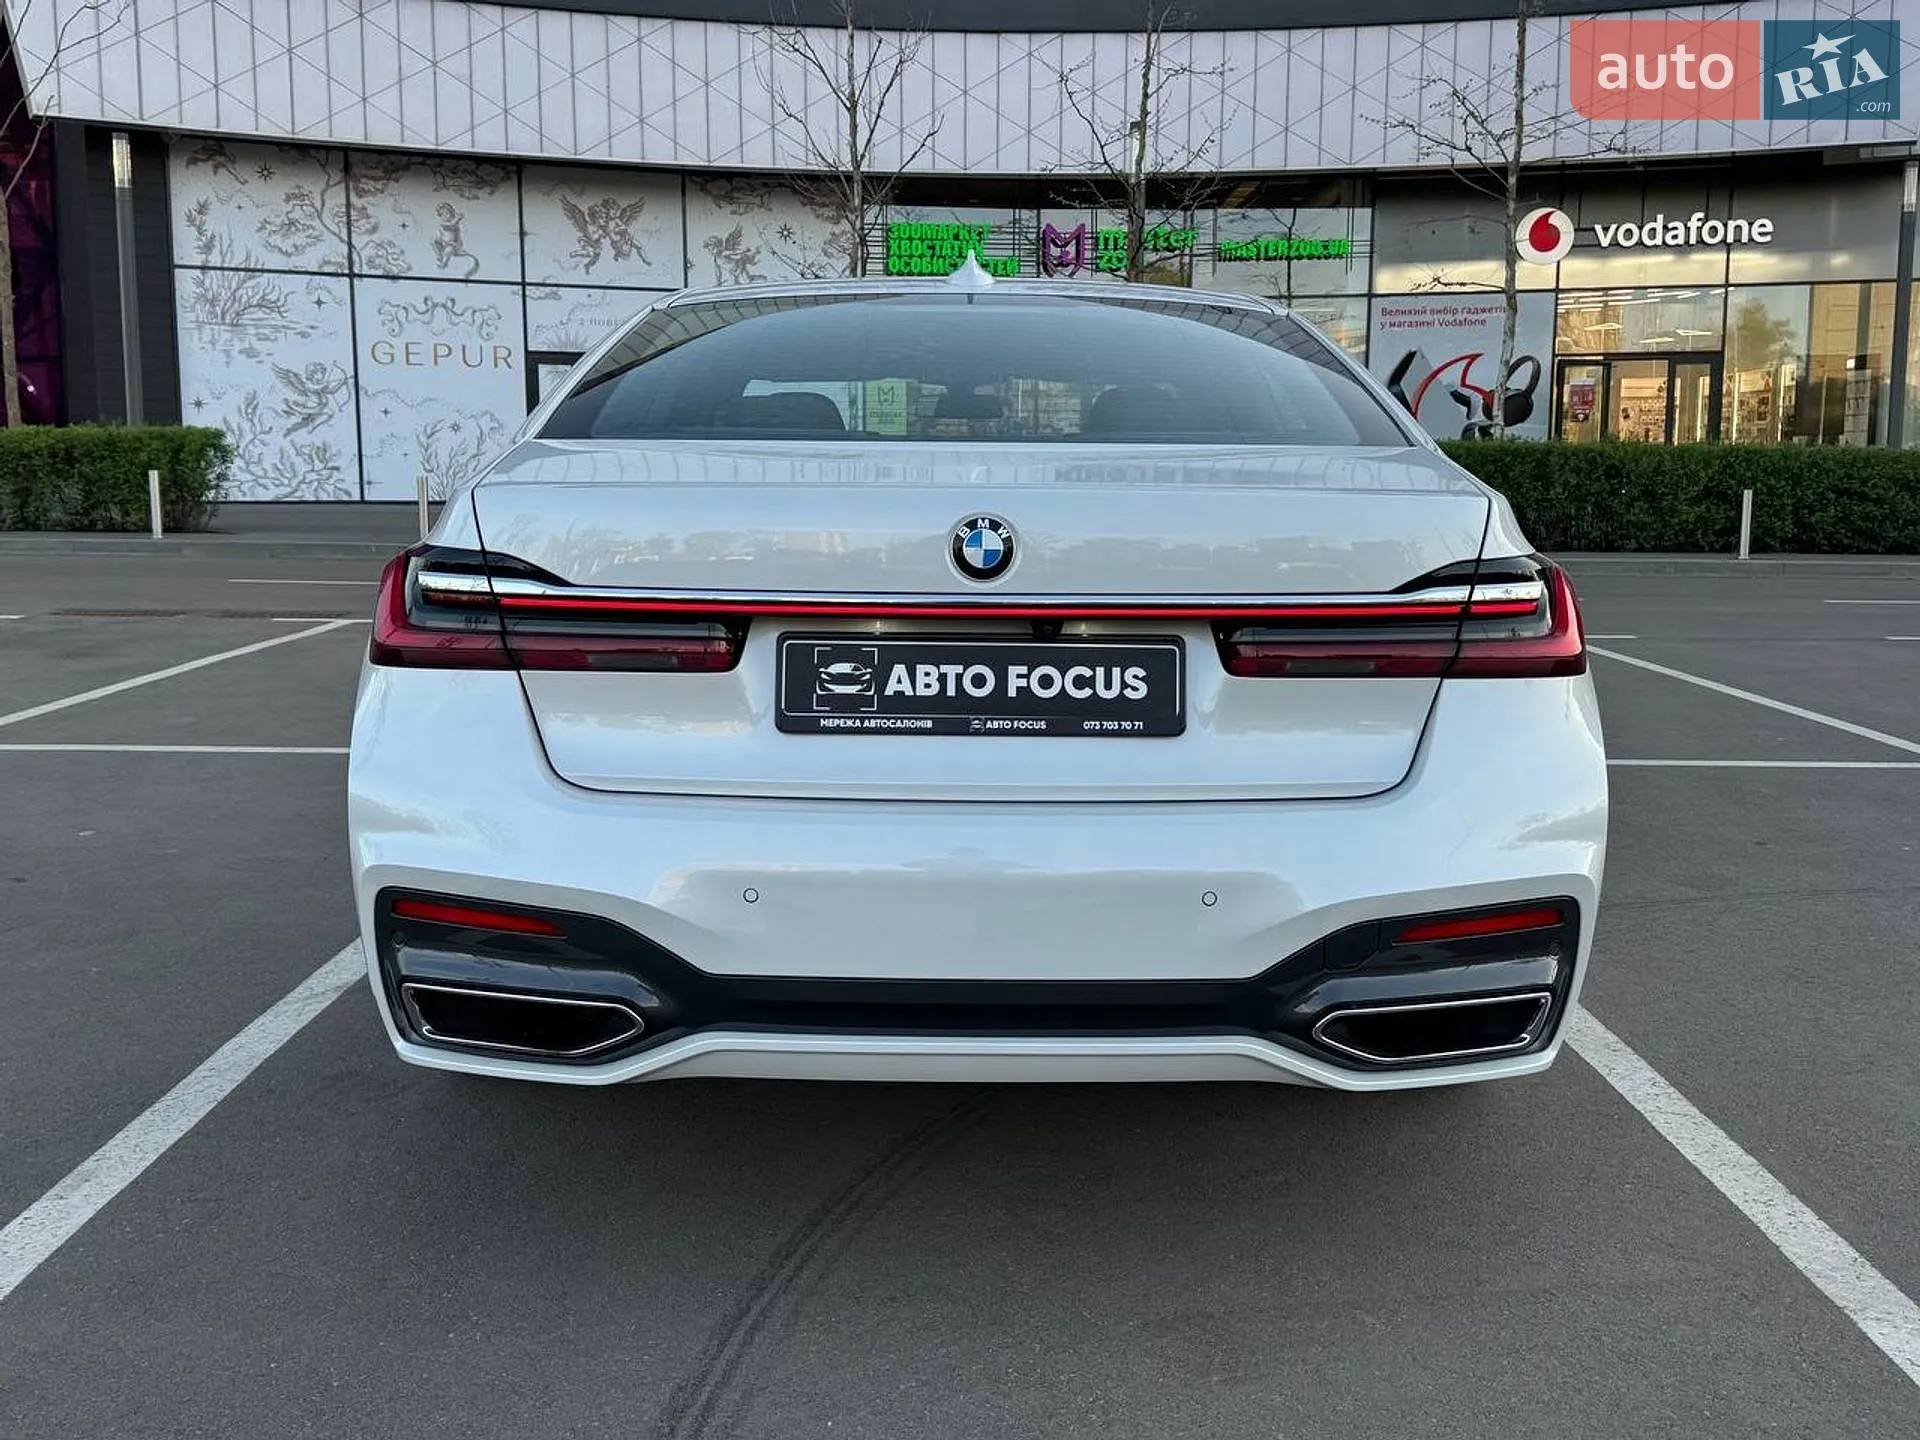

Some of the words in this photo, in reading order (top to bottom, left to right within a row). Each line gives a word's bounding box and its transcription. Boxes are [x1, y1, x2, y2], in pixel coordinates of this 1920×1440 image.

[1594, 212, 1774, 247] vodafone
[1381, 307, 1427, 317] Великий
[1429, 306, 1460, 317] вибір
[1389, 319, 1436, 328] магазині
[1438, 317, 1487, 327] Vodafone
[371, 340, 513, 370] GEPUR
[957, 518, 1011, 539] BMW
[884, 664, 996, 698] АВТО
[1007, 665, 1149, 700] FOCUS
[820, 718, 862, 728] МЕРЕЖА
[862, 719, 933, 728] АВТОСАЛОНІВ
[985, 720, 1012, 729] АВТО
[1013, 720, 1047, 730] FOCUS
[1083, 721, 1100, 730] 073
[1101, 721, 1118, 730] 703
[1120, 721, 1132, 730] 70
[1133, 721, 1144, 730] 71
